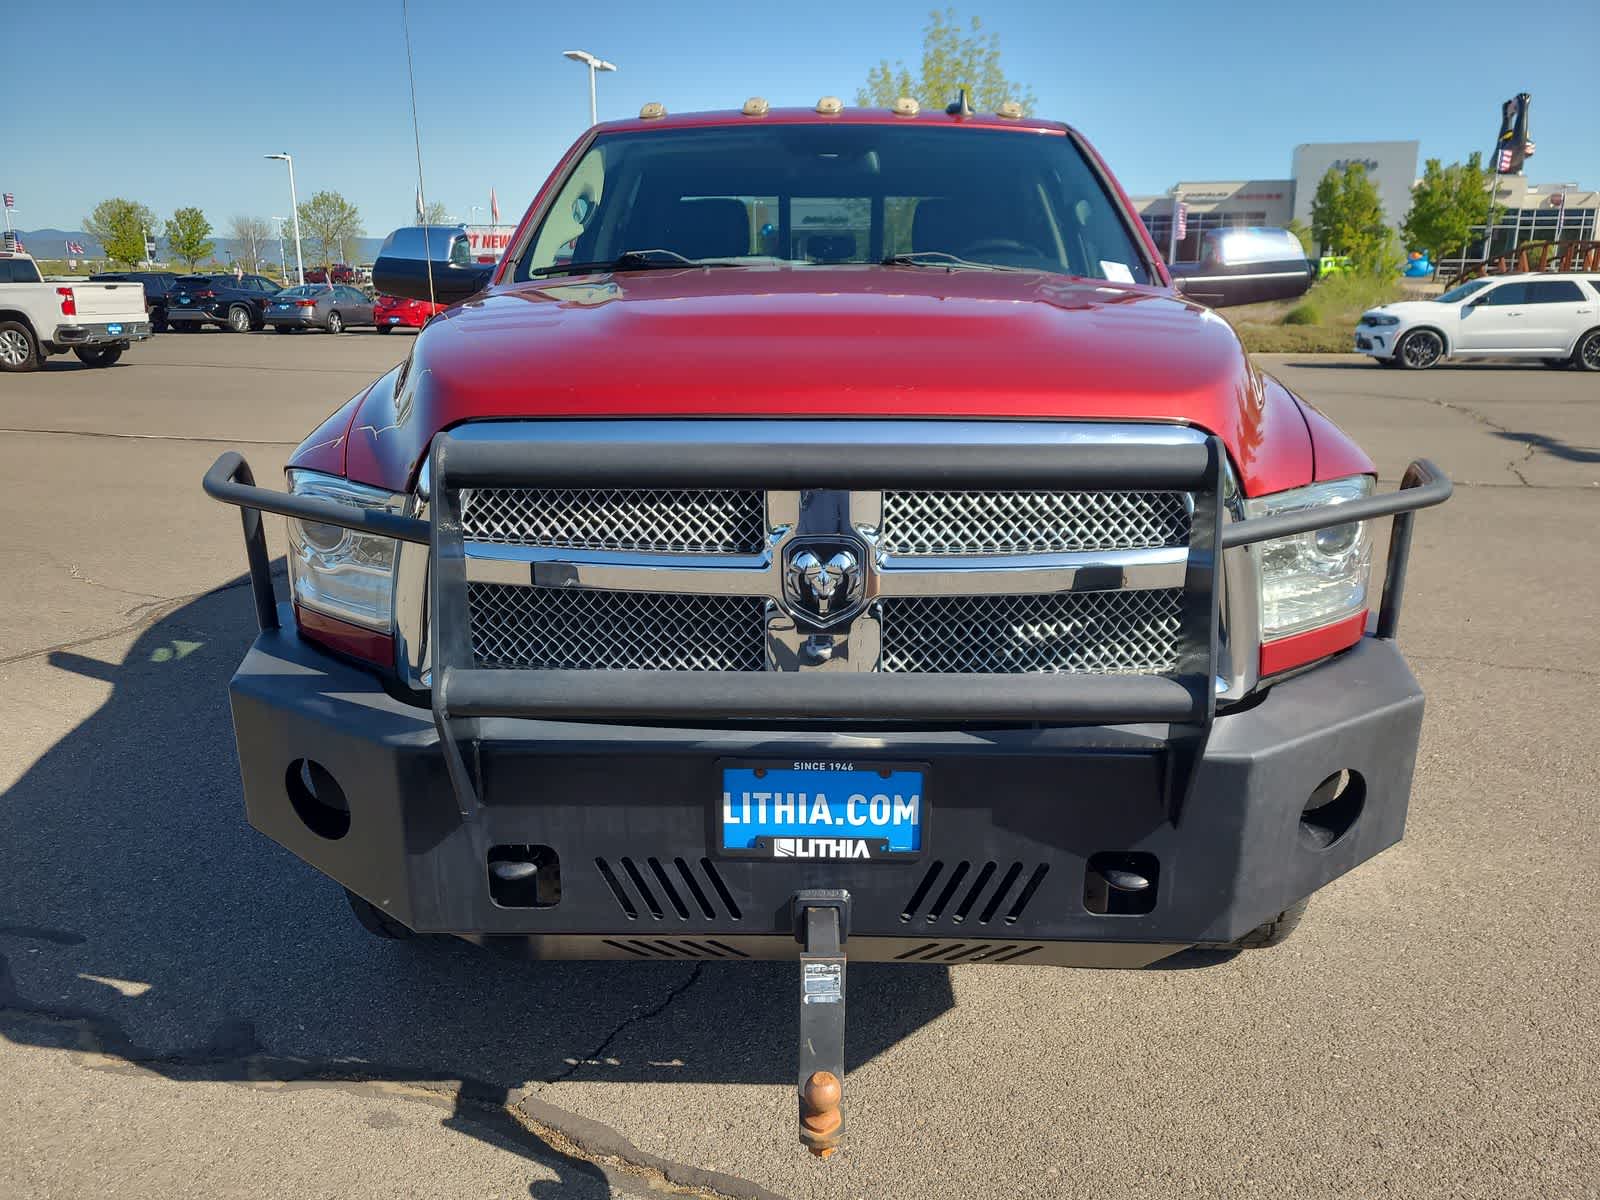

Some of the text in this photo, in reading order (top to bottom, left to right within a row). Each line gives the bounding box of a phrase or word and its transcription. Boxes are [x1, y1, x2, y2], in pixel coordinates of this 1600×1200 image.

[482, 234, 511, 249] NEW
[793, 762, 854, 772] SINCE 1946
[723, 792, 919, 826] LITHIA.COM
[796, 838, 871, 859] LITHIA
